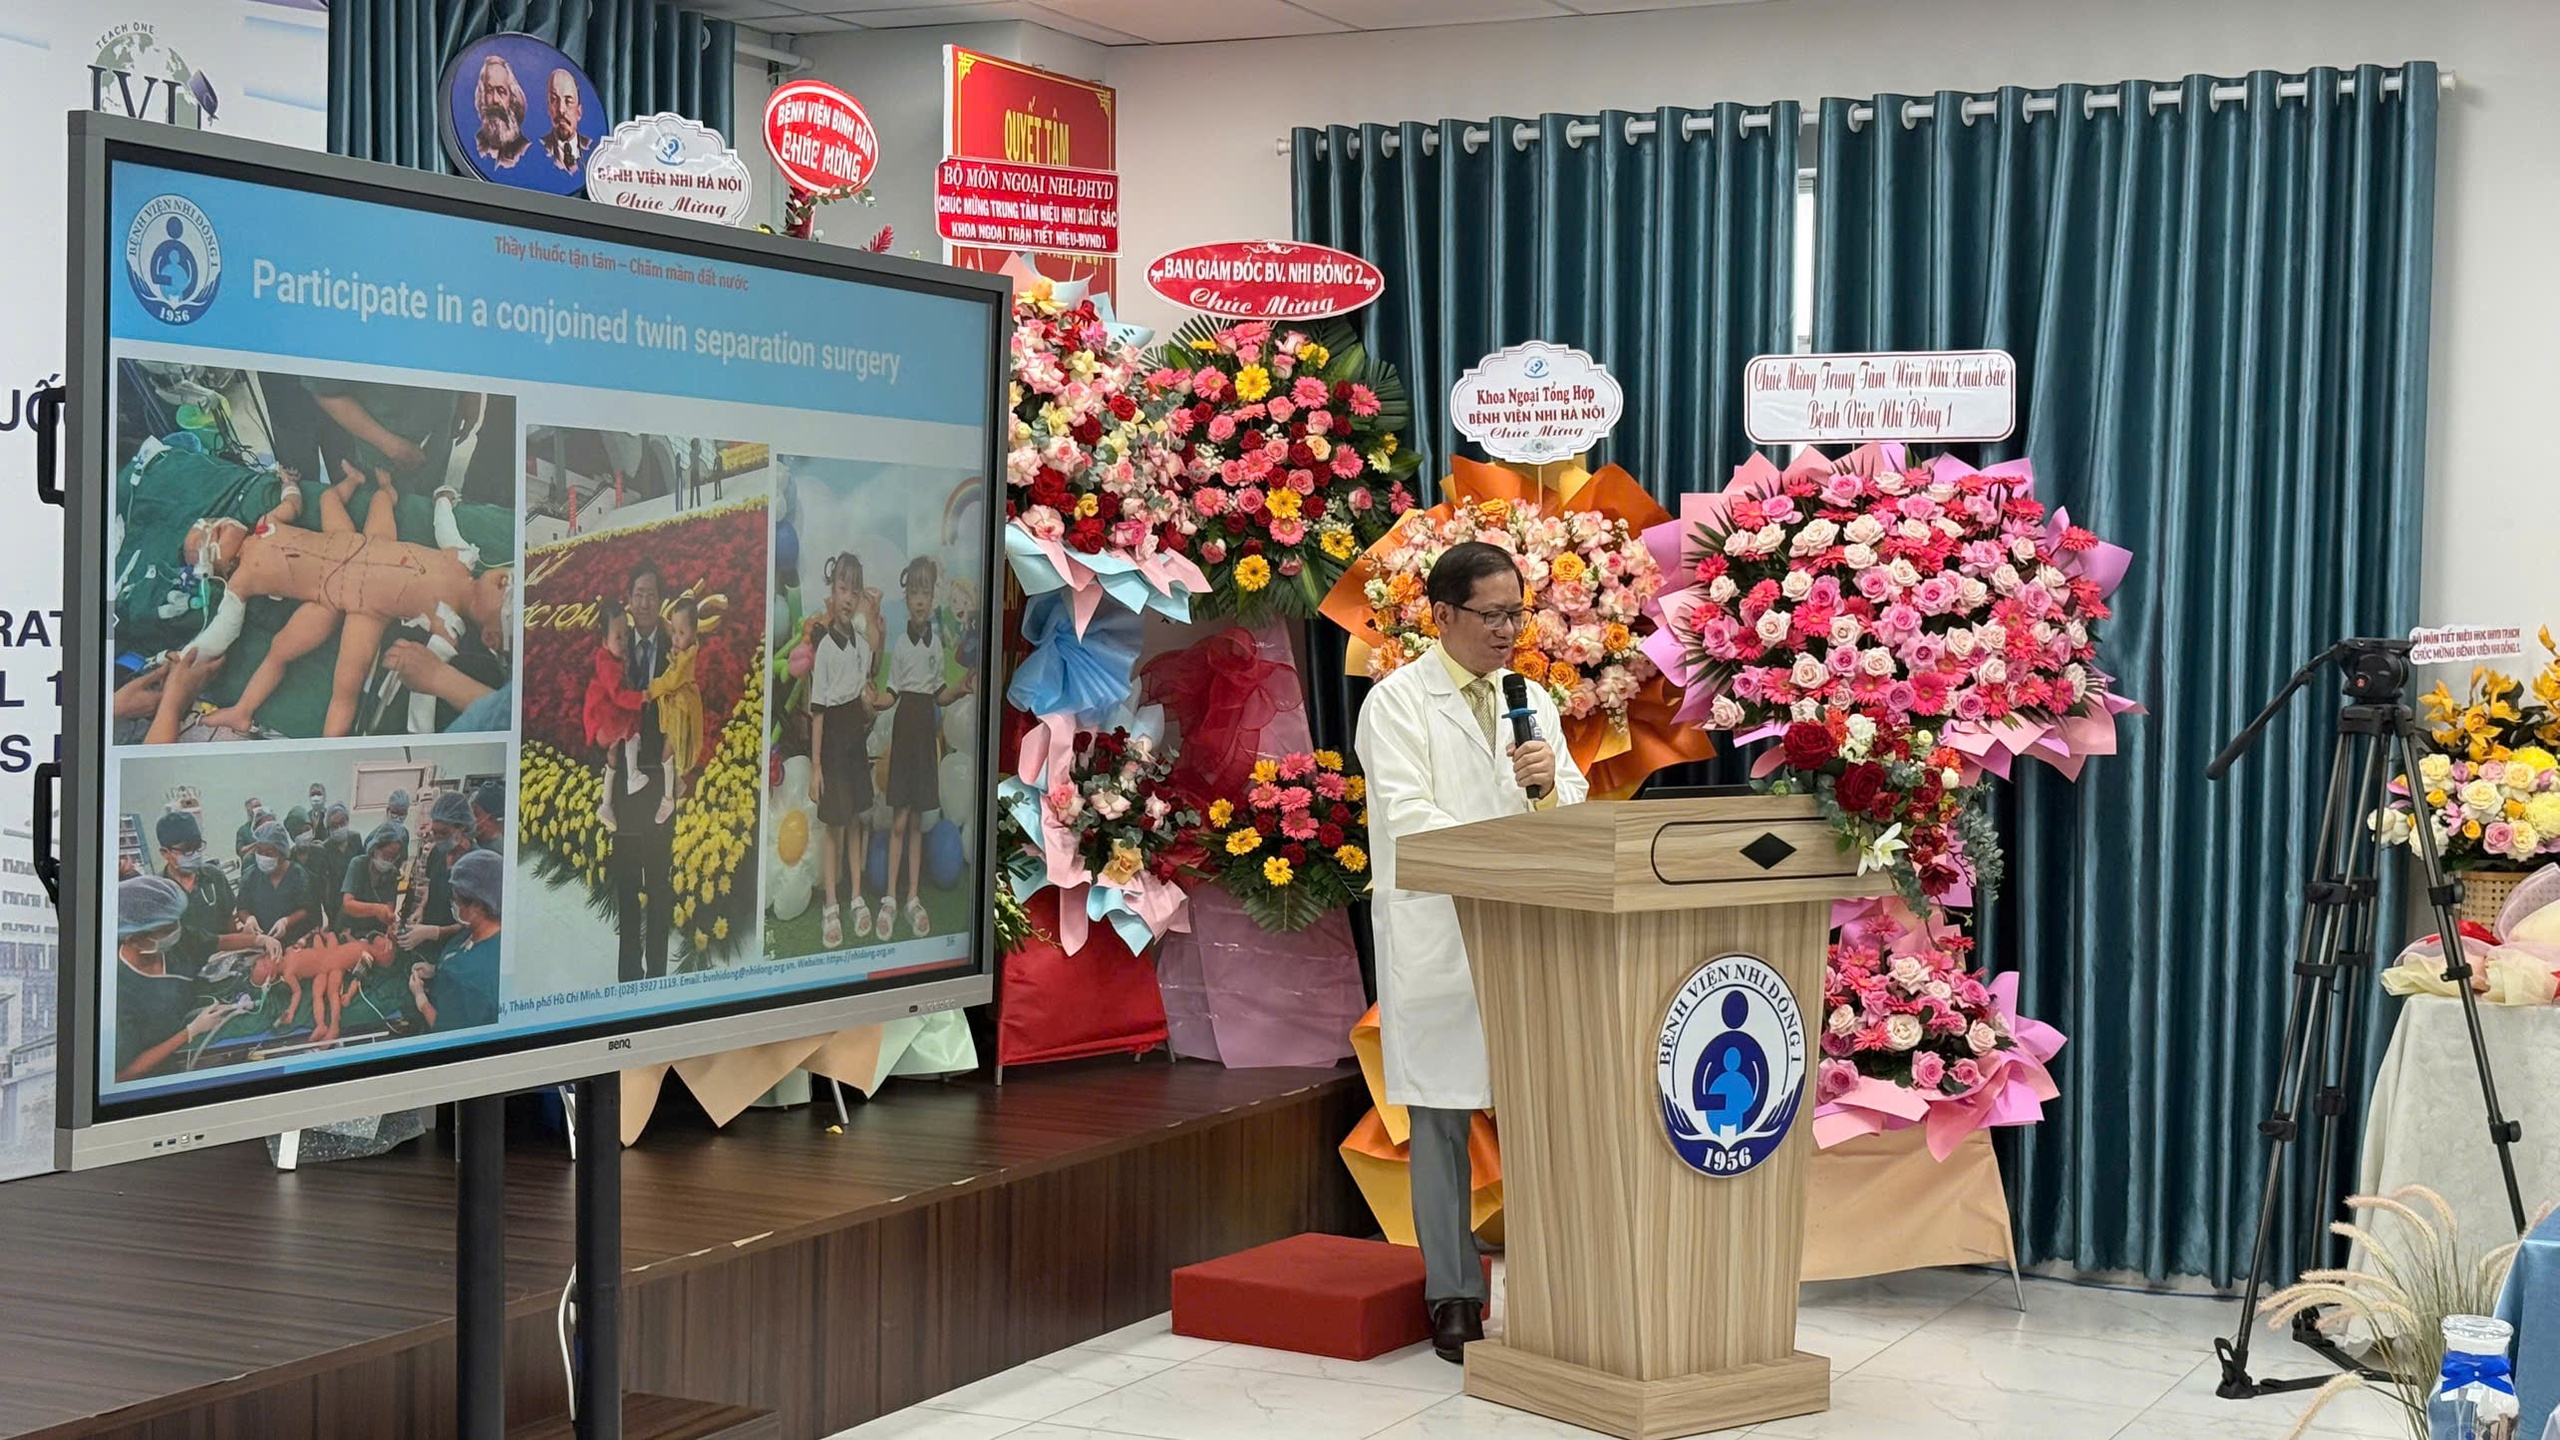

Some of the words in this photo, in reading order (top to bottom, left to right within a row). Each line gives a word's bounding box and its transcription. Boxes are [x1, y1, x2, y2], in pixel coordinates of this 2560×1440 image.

[96, 24, 129, 49] TEACH
[133, 22, 155, 35] ONE
[777, 97, 806, 130] BỆNH
[807, 99, 832, 131] VIỆN
[1004, 96, 1042, 164] QUYẾT
[1044, 107, 1070, 167] TÂM
[781, 131, 821, 170] CHÚC
[821, 140, 862, 182] MỪNG
[636, 169, 666, 188] VIỆN
[670, 173, 693, 187] NHI
[697, 173, 715, 190] HÀ
[718, 176, 742, 194] NỘI
[943, 162, 963, 191] BỘ
[966, 164, 999, 190] MÔN
[1002, 171, 1046, 197] NGOẠI
[1049, 175, 1114, 201] NHI-ĐHYD
[616, 191, 664, 211] Chúc
[669, 196, 727, 218] Mừng
[938, 191, 963, 214] CHÚC
[963, 194, 989, 217] MỪNG
[990, 200, 1019, 220] TRUNG
[1020, 199, 1039, 222] TÂM
[1040, 202, 1060, 225] NIỆU
[1061, 207, 1076, 224] NHI
[1077, 203, 1100, 227] XUẤT
[951, 221, 976, 238] KHOA
[978, 225, 1006, 243] NGOẠI
[1008, 224, 1032, 245] THẬN
[1033, 224, 1054, 244] TIẾT
[494, 235, 526, 262] Thầy
[529, 241, 566, 264] thuốc
[569, 249, 589, 269] tận
[592, 252, 616, 271] tâm
[719, 274, 749, 292] nước
[1164, 258, 1194, 279] BAN
[1195, 254, 1231, 280] GIÁM
[1265, 262, 1286, 283] BV.
[1288, 263, 1312, 283] NHI
[1354, 264, 1364, 285] 2
[160, 307, 190, 322] 1956
[1189, 288, 1252, 314] Chúc
[1258, 295, 1336, 316] Mừng
[253, 258, 428, 322] Participate
[437, 283, 463, 324] in
[471, 298, 488, 328] a
[496, 299, 628, 344] conjoined
[635, 314, 687, 352] twin
[694, 326, 815, 367] separation
[822, 343, 901, 386] surgery
[1477, 389, 1505, 405] Khoa
[1508, 387, 1539, 407] Ngoại
[1542, 381, 1569, 404] Tổng
[1572, 385, 1595, 405] Hợp
[1754, 362, 1782, 392] Chúc
[1783, 362, 1818, 398] Mừng
[1820, 361, 1855, 397] Trung
[1859, 360, 1886, 391] Tâm
[1925, 359, 1949, 388] Nhi
[1468, 410, 1500, 427] BỆNH
[1503, 408, 1531, 425] VIỆN
[1535, 409, 1557, 422] NHI
[1561, 406, 1579, 421] HÀ
[1581, 405, 1605, 422] NỘI
[1489, 427, 1530, 439] Chúc
[1535, 424, 1584, 438] Mừng
[1807, 400, 1840, 437] Bệnh
[1843, 399, 1874, 436] Viện
[1878, 399, 1904, 428] Nhi
[1906, 396, 1942, 434] Đồng
[1946, 401, 1953, 427] 1
[509, 998, 535, 1013] Thành
[619, 982, 638, 997] (028)
[639, 980, 657, 993] 3927
[1659, 998, 1689, 1067] BỆNH
[1687, 964, 1730, 998] VIỆN
[1734, 964, 1769, 989] NHI
[1703, 1147, 1752, 1171] 1956
